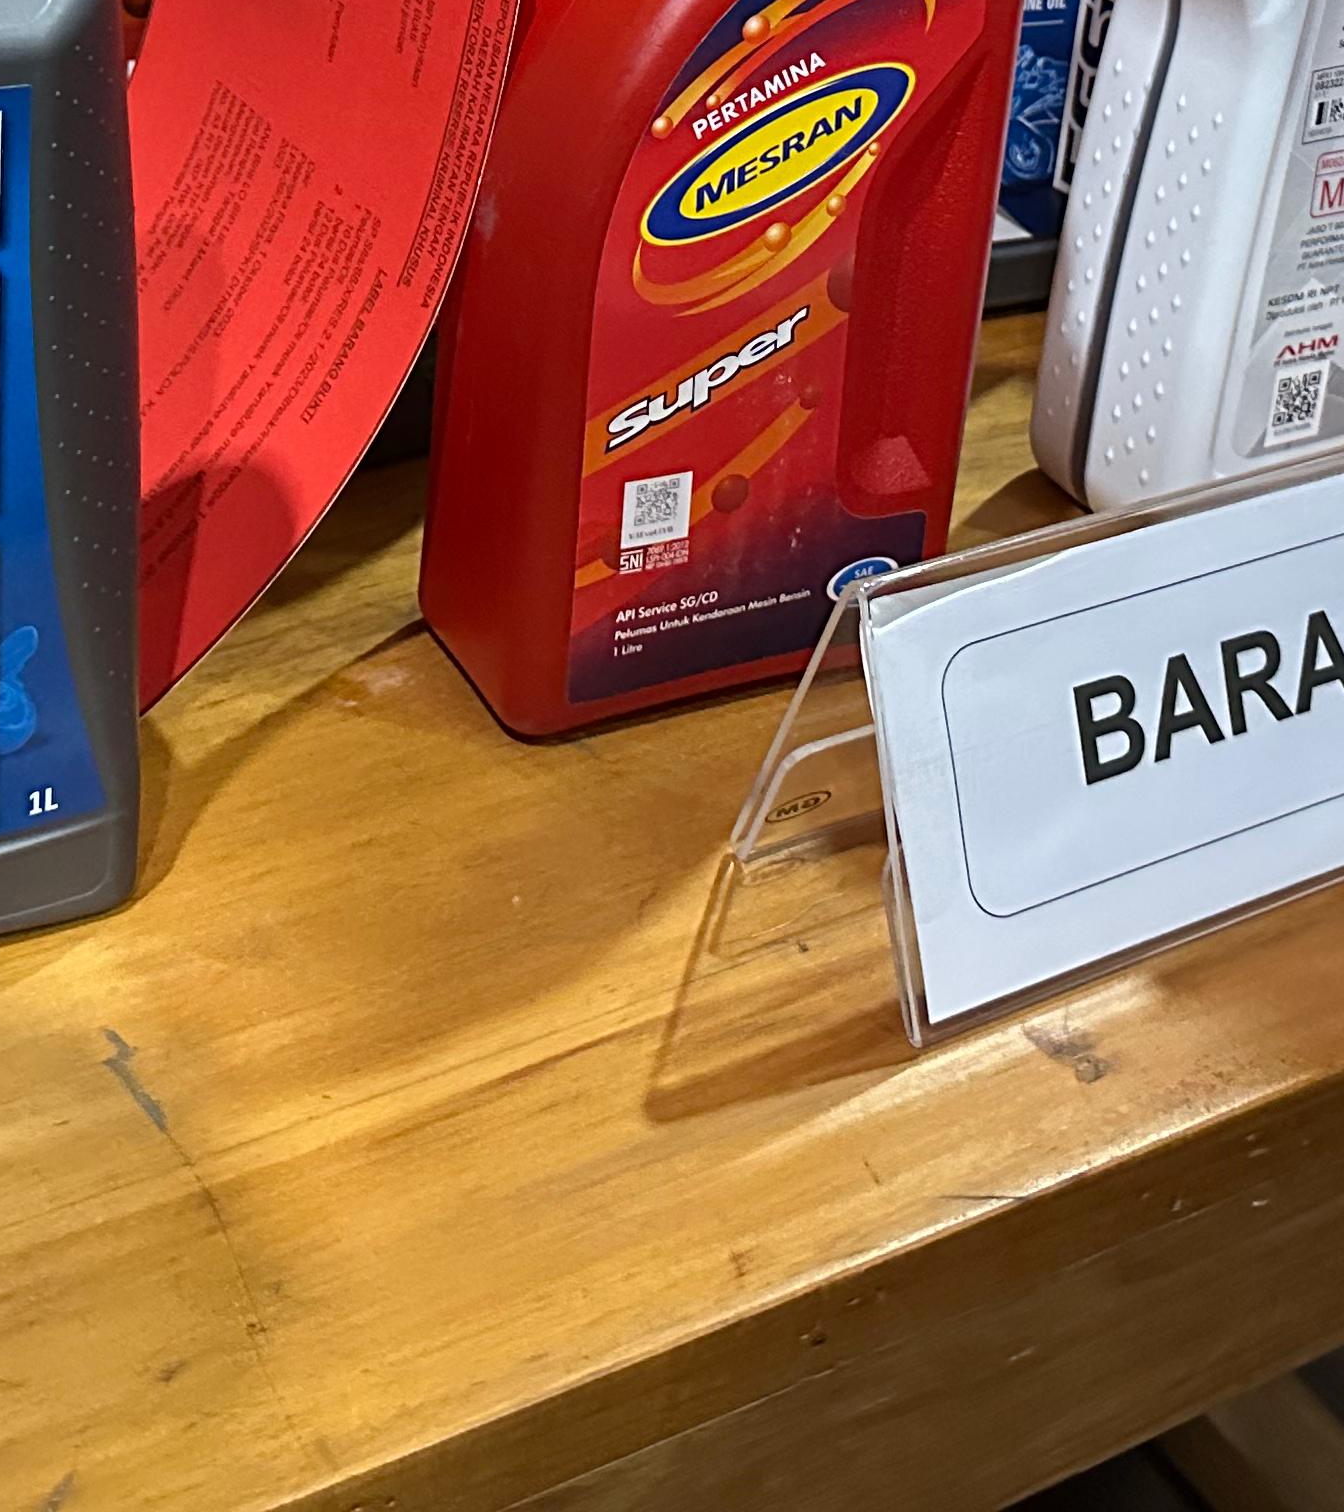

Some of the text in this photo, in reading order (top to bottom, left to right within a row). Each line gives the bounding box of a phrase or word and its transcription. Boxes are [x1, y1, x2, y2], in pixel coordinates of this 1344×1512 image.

[442, 77, 469, 150] RESERSE
[467, 81, 494, 149] NEGARA
[692, 52, 826, 140] PERTAMINA
[424, 26, 493, 256] DAERAH KALIMANTAN TENGAH
[695, 96, 863, 214] MESRAN
[422, 151, 452, 222] KRIMINAL
[446, 149, 477, 226] REPUBLIK
[400, 224, 430, 288] KHUSUS
[419, 227, 456, 309] INDONESIA
[299, 268, 389, 425] LABEL BARANG BUKTI
[605, 304, 808, 451] Super
[619, 550, 644, 572] SNI
[854, 565, 875, 579] SAE
[613, 588, 812, 641] Pelumas Untuk Kendaraan Mesin Bensin
[615, 590, 720, 623] API Service SG/CD
[620, 641, 644, 656] Litre
[28, 787, 59, 817] 1L
